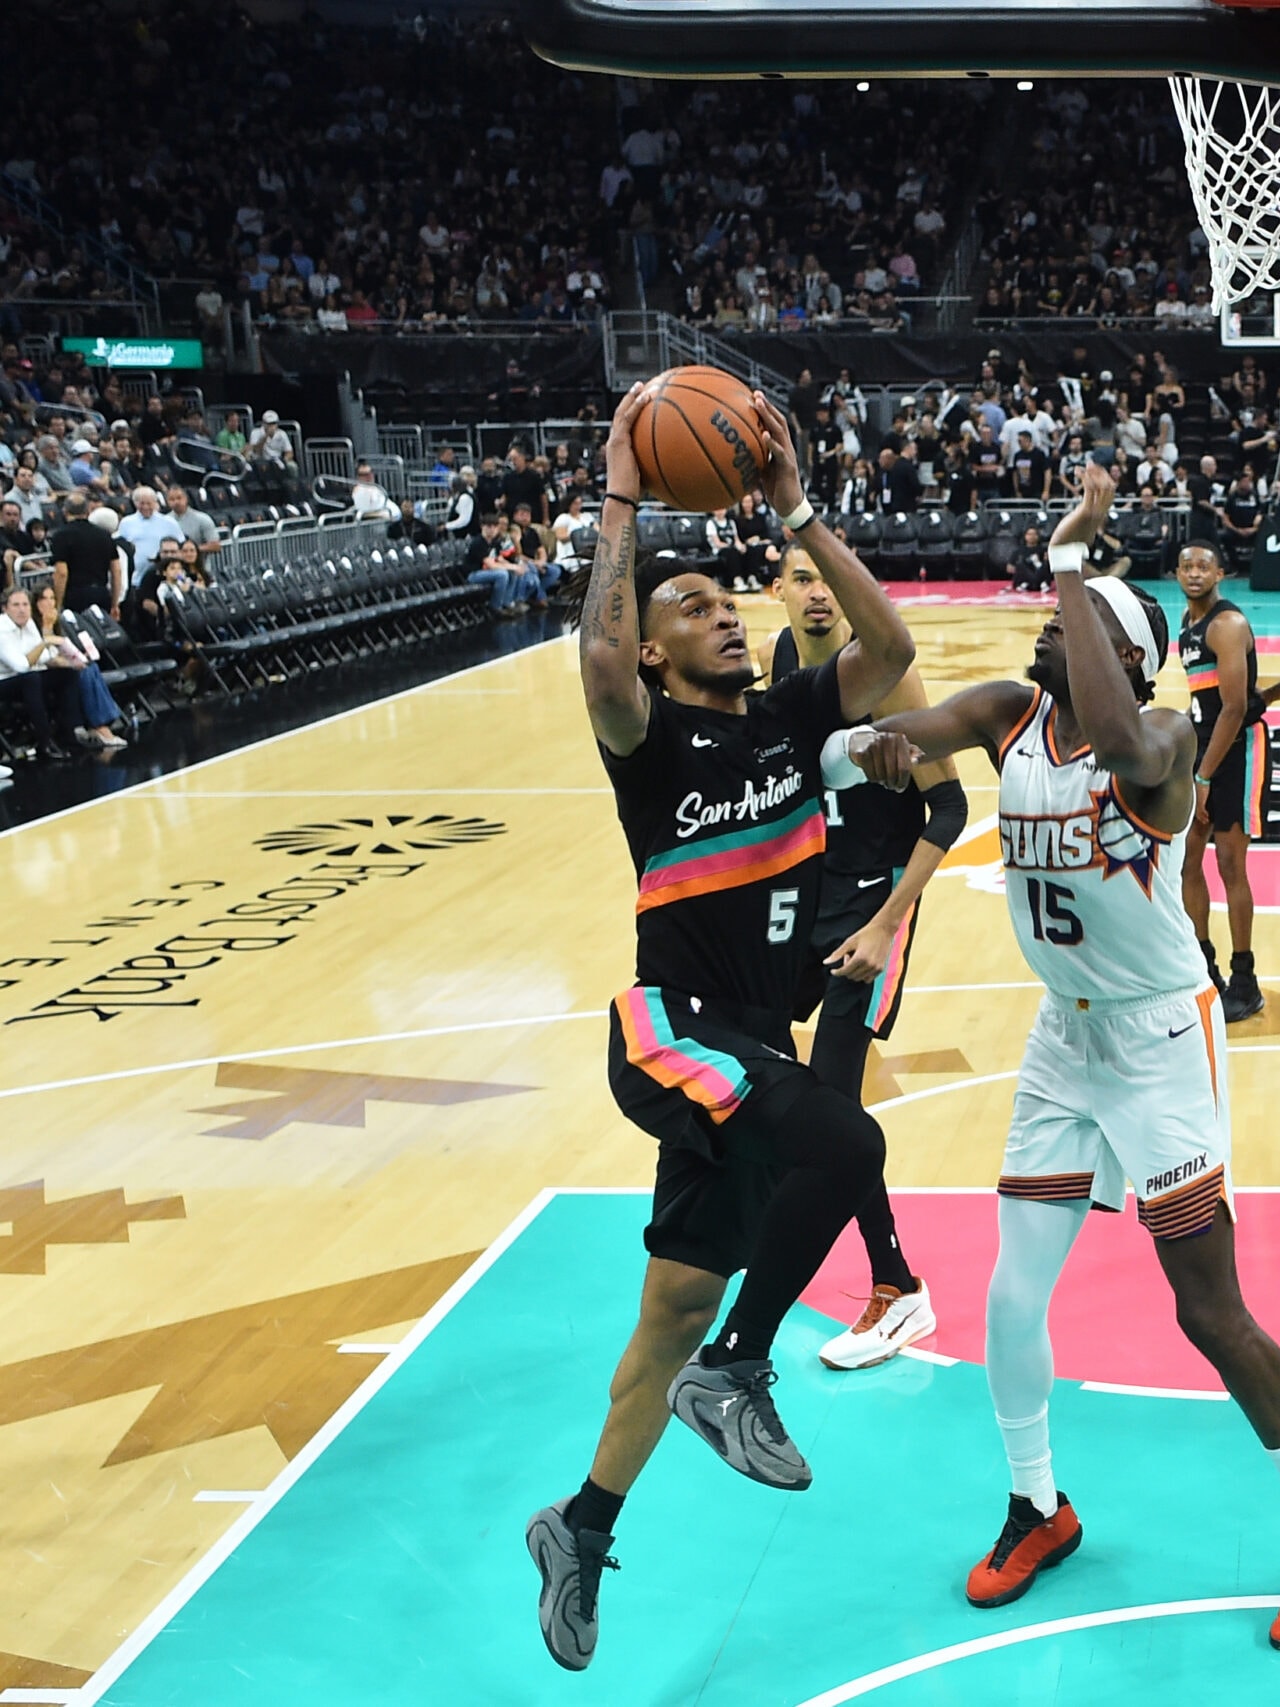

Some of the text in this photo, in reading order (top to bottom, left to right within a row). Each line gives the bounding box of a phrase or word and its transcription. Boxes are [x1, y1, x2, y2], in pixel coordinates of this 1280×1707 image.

[675, 764, 803, 839] San Antonio
[2, 861, 428, 1025] Frost Bank
[766, 888, 800, 944] 5
[1026, 878, 1084, 946] 15
[1145, 1151, 1208, 1195] PHOENIX
